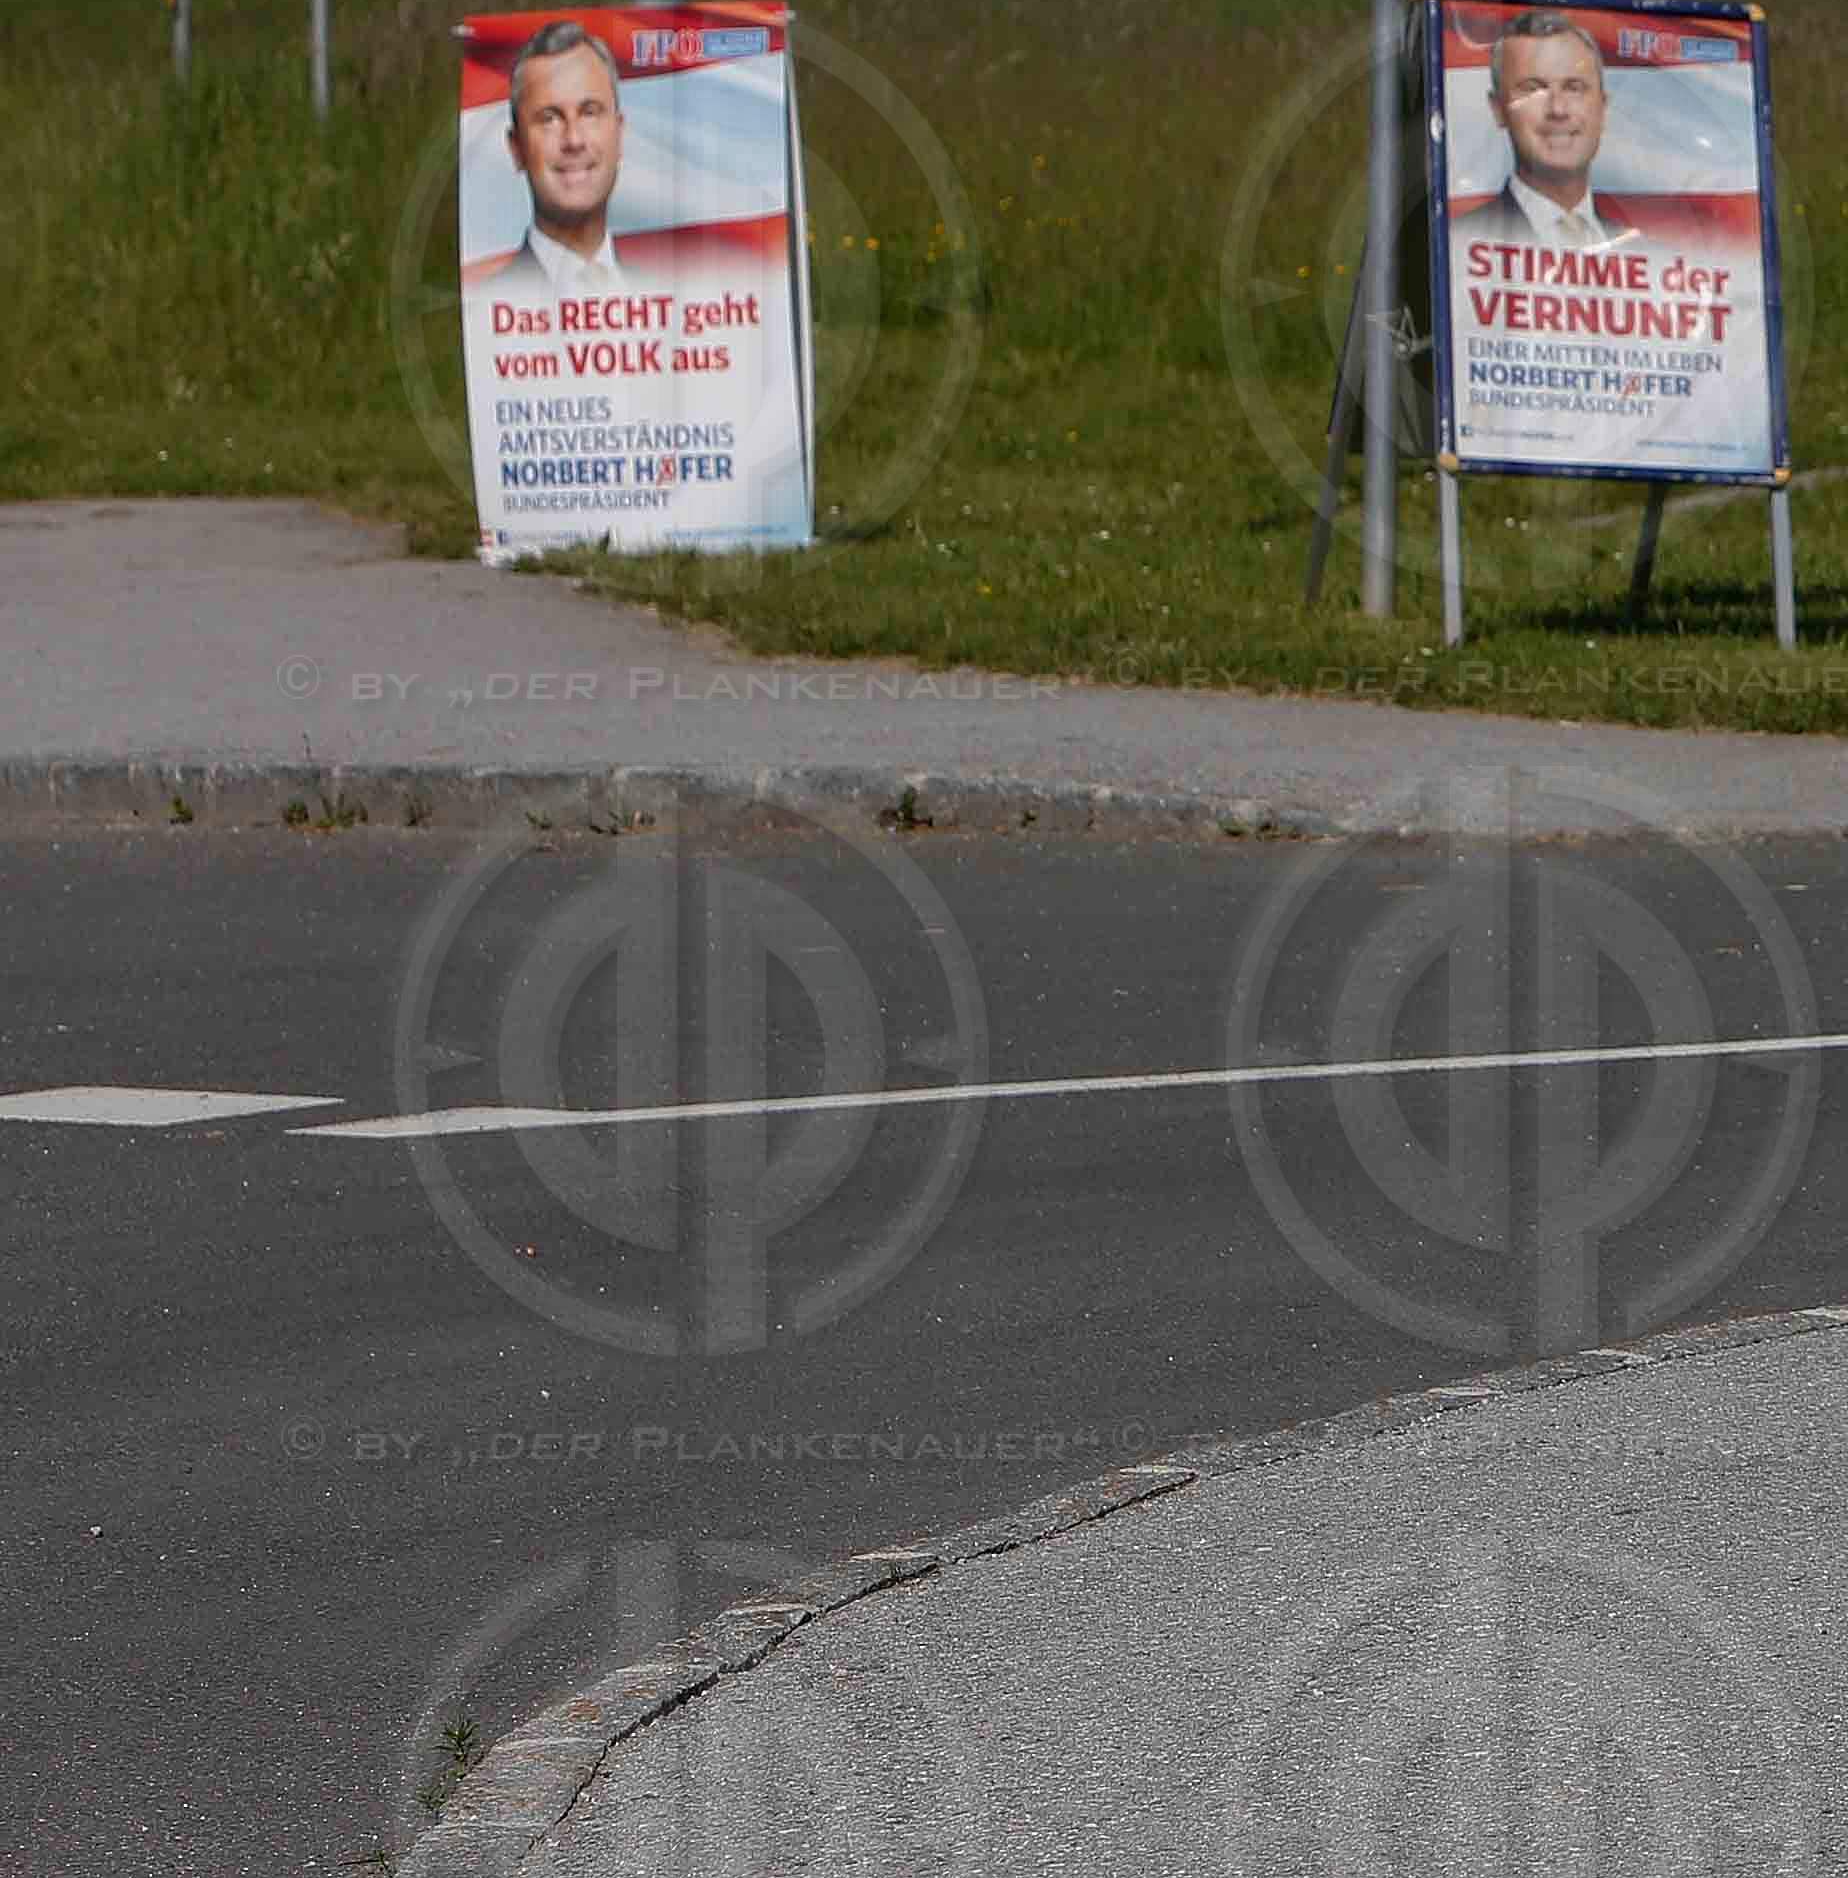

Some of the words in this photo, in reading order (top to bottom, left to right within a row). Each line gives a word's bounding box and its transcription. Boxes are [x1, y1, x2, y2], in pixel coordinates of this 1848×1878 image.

[1467, 241, 1648, 292] STIMME
[1660, 257, 1731, 296] der
[491, 302, 551, 336] Das
[558, 295, 675, 334] RECHT
[681, 291, 761, 336] geht
[1468, 287, 1733, 344] VERNUNFT
[495, 352, 561, 380] vom
[566, 340, 663, 376] VOLK
[670, 343, 732, 373] aus
[1467, 337, 1529, 361] EINER
[1533, 340, 1618, 369] MITTEN
[1623, 348, 1652, 369] IM
[1655, 349, 1724, 374] LEBEN
[1468, 364, 1597, 393] NORBERT
[495, 400, 531, 424] EIN
[536, 396, 613, 422] NEUES
[498, 421, 736, 455] AMTSVERSTÄNDNIS
[501, 457, 627, 488] NORBERT
